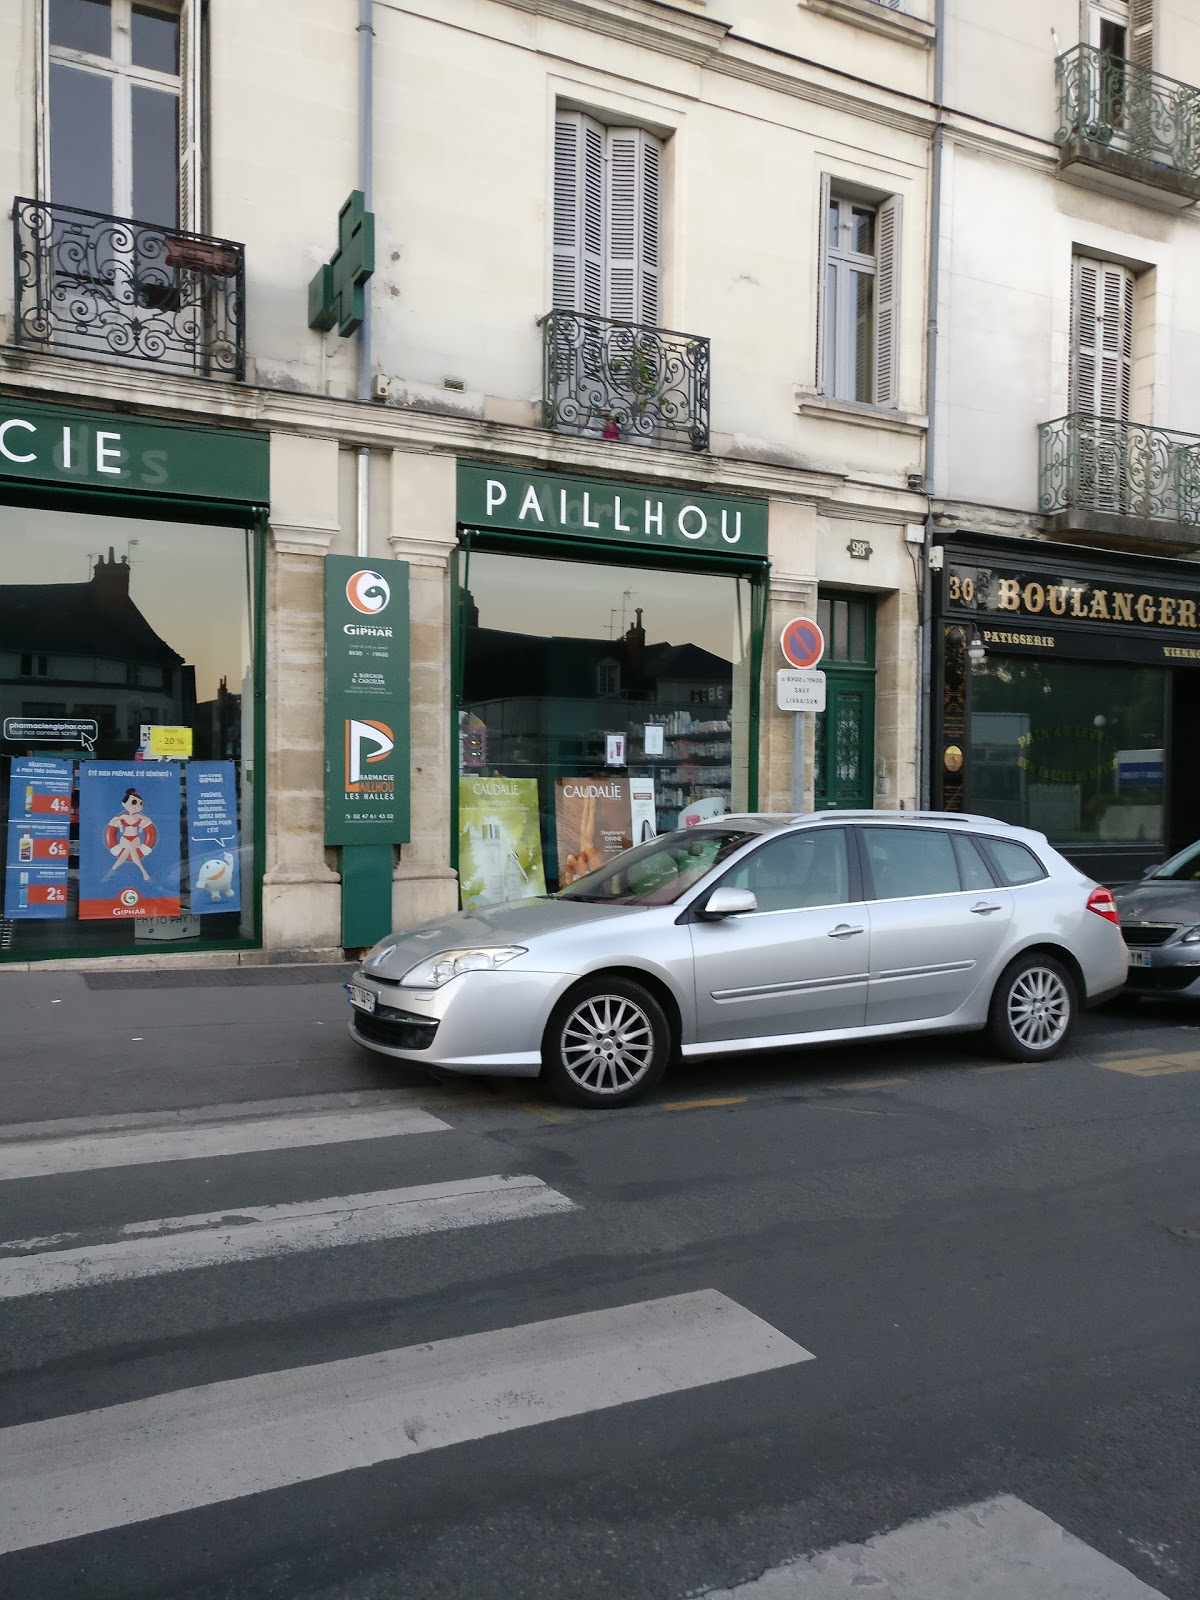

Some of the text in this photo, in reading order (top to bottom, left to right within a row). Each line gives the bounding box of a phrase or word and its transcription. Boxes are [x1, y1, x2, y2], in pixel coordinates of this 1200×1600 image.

[486, 479, 742, 544] PAILLHOU
[949, 576, 1200, 629] 30 BOULANGER
[343, 624, 393, 637] GIPHAR
[983, 630, 1055, 647] PATISSERIE
[164, 737, 174, 745] 20
[473, 782, 519, 796] CAUDALIE
[563, 782, 622, 798] CAUDALIE
[113, 907, 146, 916] GIPHAR
